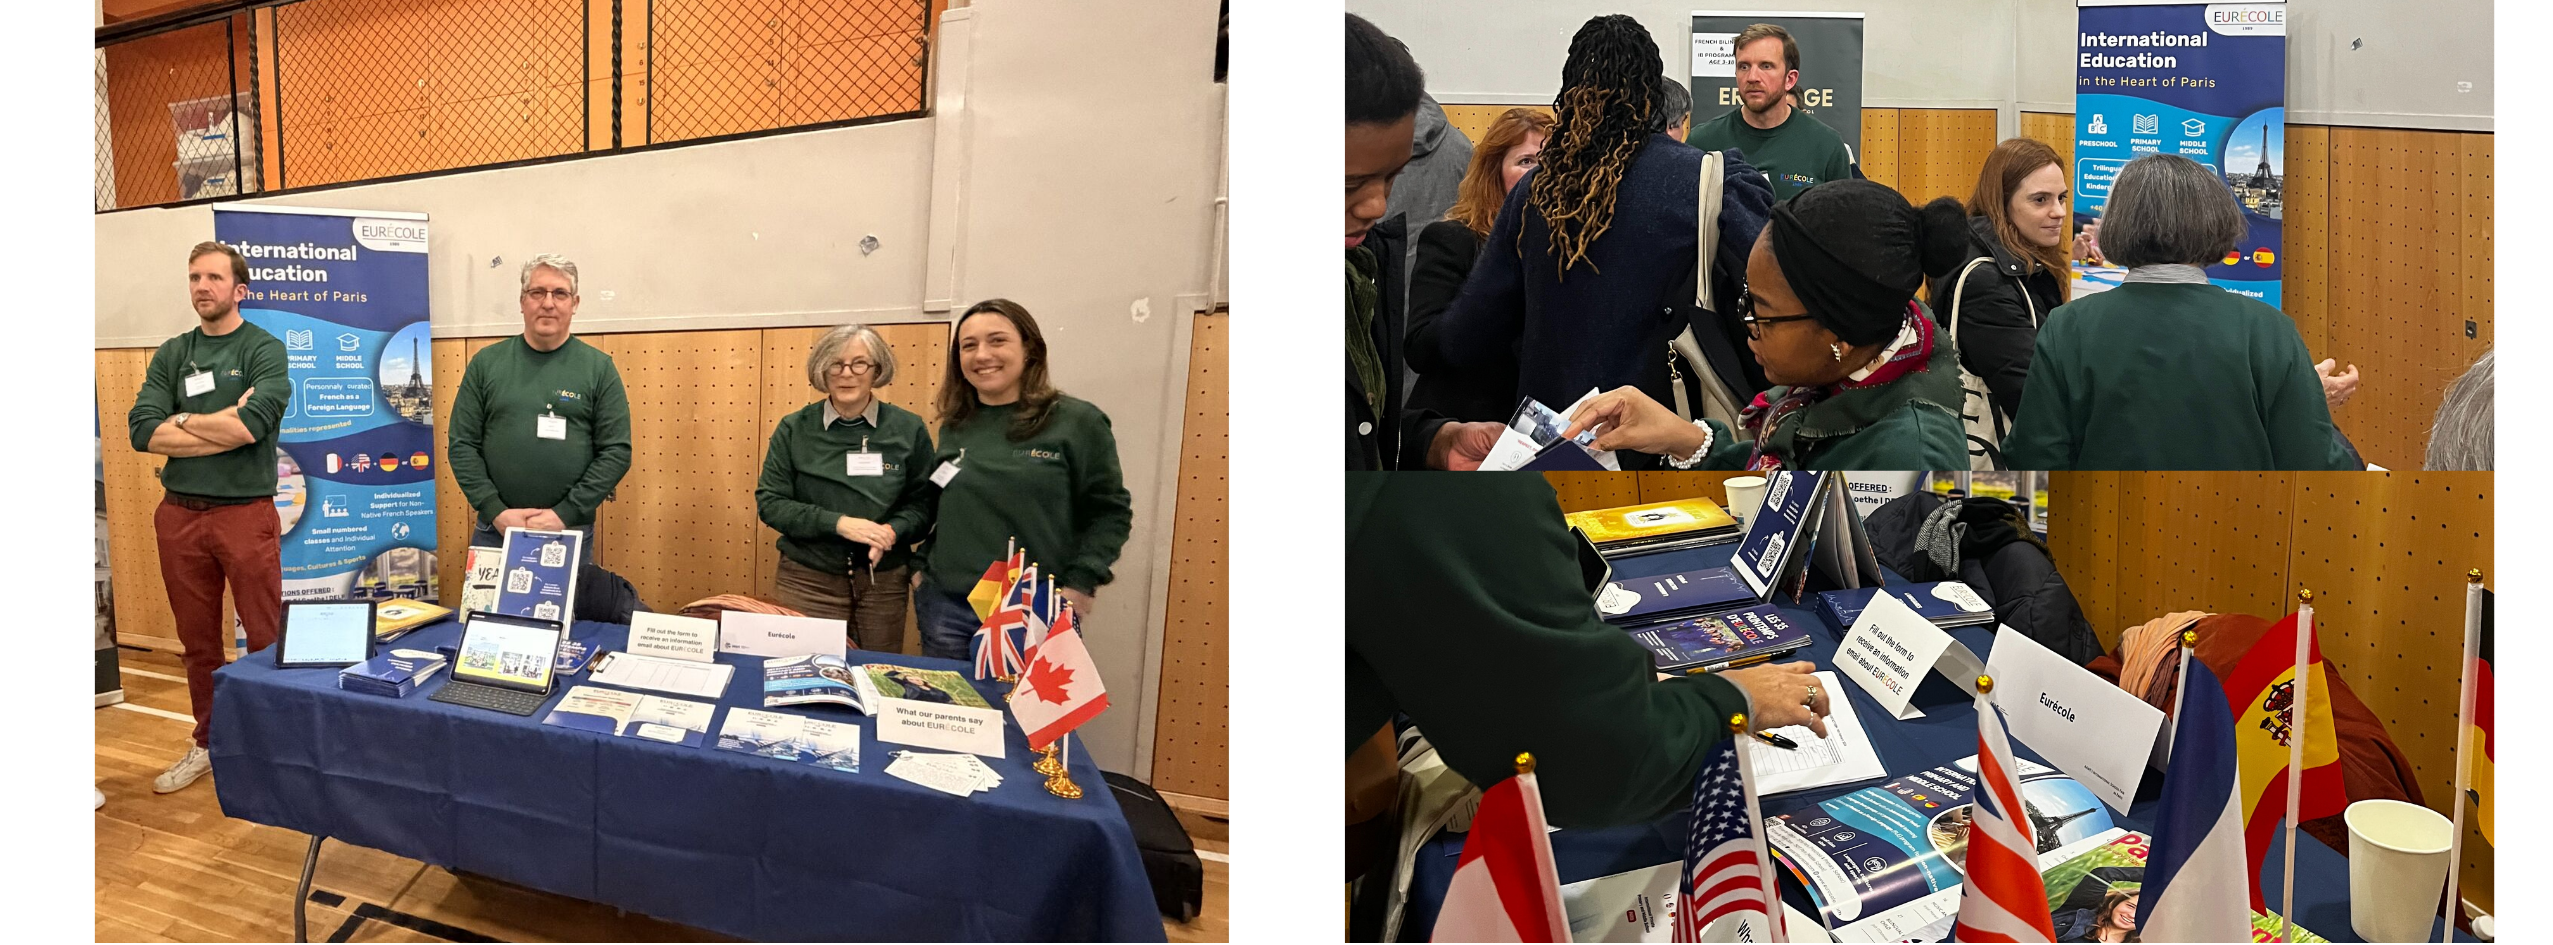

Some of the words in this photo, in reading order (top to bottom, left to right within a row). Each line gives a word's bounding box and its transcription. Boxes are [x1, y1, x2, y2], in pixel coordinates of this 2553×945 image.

[2214, 7, 2283, 23] EURÉCOLE
[2080, 31, 2208, 48] International
[2080, 52, 2177, 69] Education
[2079, 76, 2090, 86] in
[2094, 76, 2116, 86] the
[2120, 76, 2157, 87] Heart
[2162, 76, 2176, 87] of
[2181, 76, 2216, 88] Paris
[2079, 139, 2118, 148] PRESCHOOL
[2130, 138, 2162, 146] PRIMARY
[2179, 140, 2207, 148] MIDDLE
[2093, 164, 2122, 172] Trilingua
[1780, 173, 1814, 184] EURÉCOLE
[2086, 183, 2112, 191] Kinderg
[362, 223, 426, 240] EURÉCOLE
[248, 265, 328, 282] ucation
[243, 289, 264, 301] he
[269, 290, 309, 301] Heart
[314, 291, 328, 302] of
[333, 291, 368, 303] Paris
[307, 404, 335, 412] Foreign
[336, 404, 370, 412] Language
[308, 420, 352, 433] represented
[1848, 482, 1888, 492] OFFERED
[374, 491, 421, 499] Individualized
[1854, 495, 1879, 504] oethe
[370, 501, 398, 509] Support
[361, 511, 381, 519] Native
[405, 509, 433, 517] Speakers
[332, 525, 368, 533] numbered
[304, 537, 330, 545] classes
[345, 534, 376, 542] Individual
[325, 544, 356, 553] Attention
[307, 562, 336, 571] Cultures
[343, 555, 366, 564] Sports
[301, 587, 331, 595] OFFERED
[1764, 613, 1781, 624] LES
[1743, 611, 1779, 640] PRINTEMPS
[677, 630, 691, 638] form
[767, 631, 795, 640] Eurécole
[670, 637, 702, 646] information
[1869, 623, 1879, 635] Fill
[1876, 631, 1888, 642] out
[1885, 635, 1896, 648] the
[1894, 641, 1909, 657] form
[1906, 651, 1915, 662] to
[1856, 635, 1874, 653] receive
[1872, 648, 1881, 658] an
[1879, 651, 1909, 680] information
[1846, 647, 1861, 661] email
[1858, 656, 1875, 672] about
[1871, 666, 1904, 696] EURÉCOLE
[2039, 691, 2076, 723] Eurécole
[896, 707, 917, 716] What
[934, 713, 967, 723] parents
[968, 717, 984, 726] say
[901, 719, 925, 728] about
[1920, 859, 1939, 892] on-native
